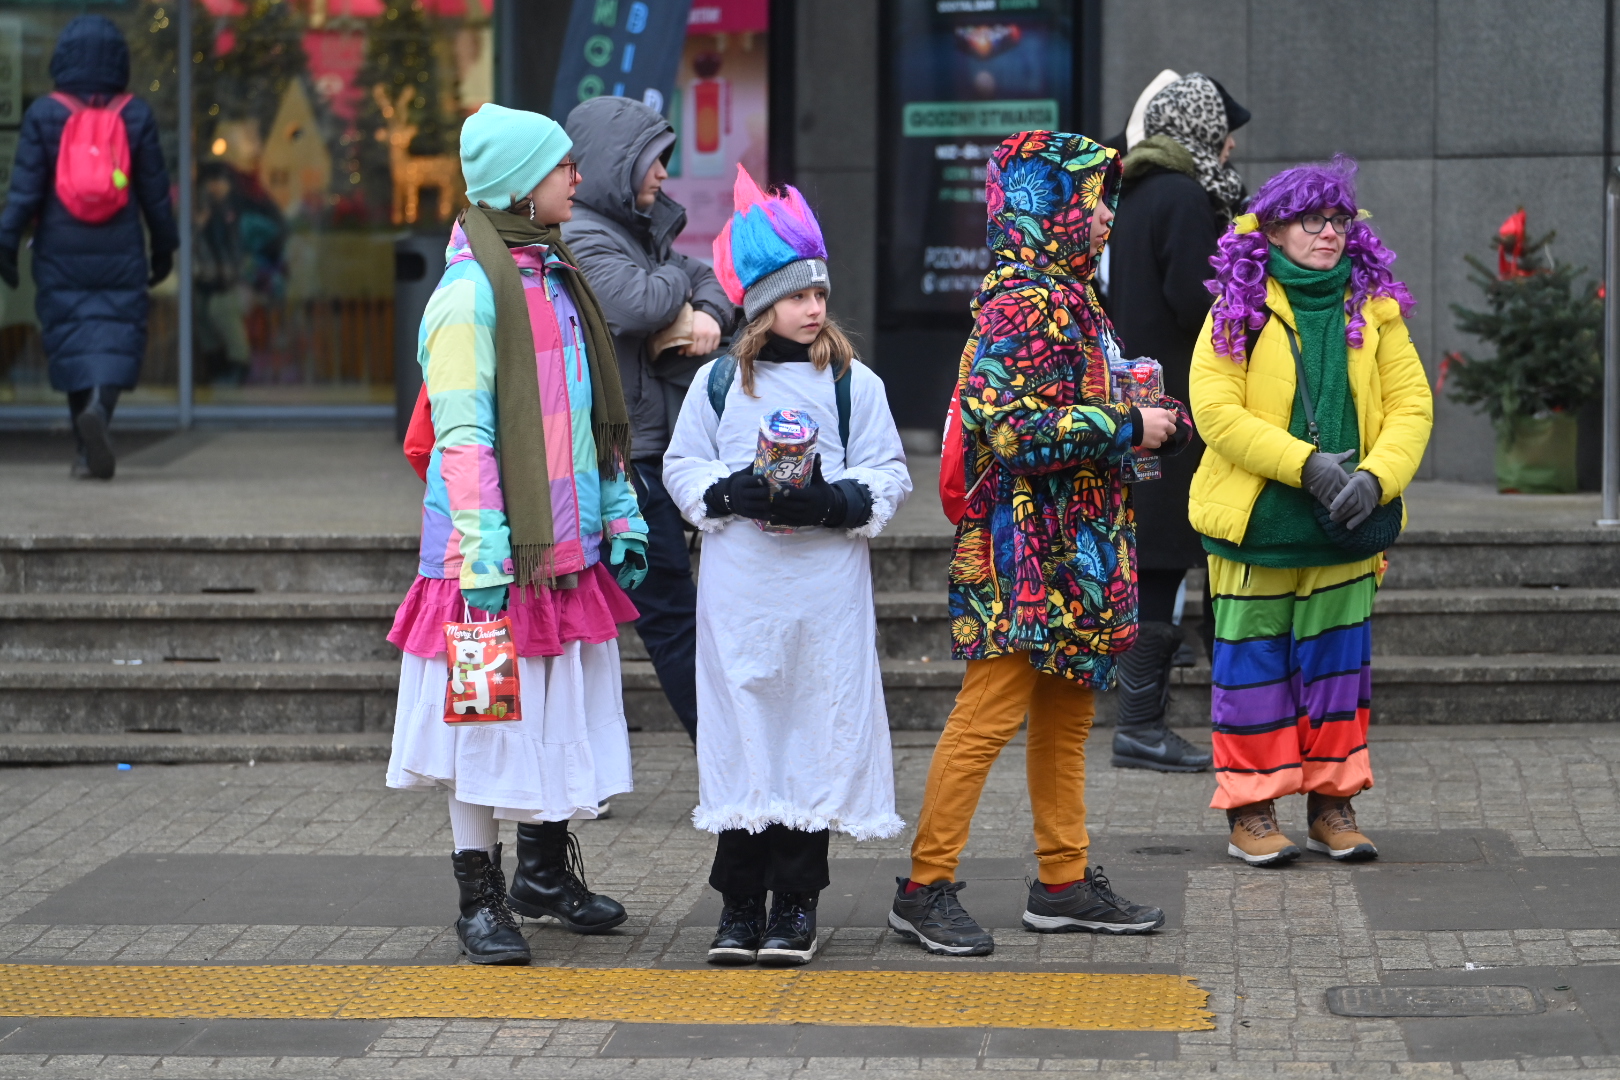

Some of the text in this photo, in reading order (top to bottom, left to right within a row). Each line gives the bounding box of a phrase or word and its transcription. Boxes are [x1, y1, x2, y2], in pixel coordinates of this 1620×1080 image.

[807, 260, 826, 283] L
[772, 458, 806, 481] 34
[446, 625, 506, 639] Merry Christmas
